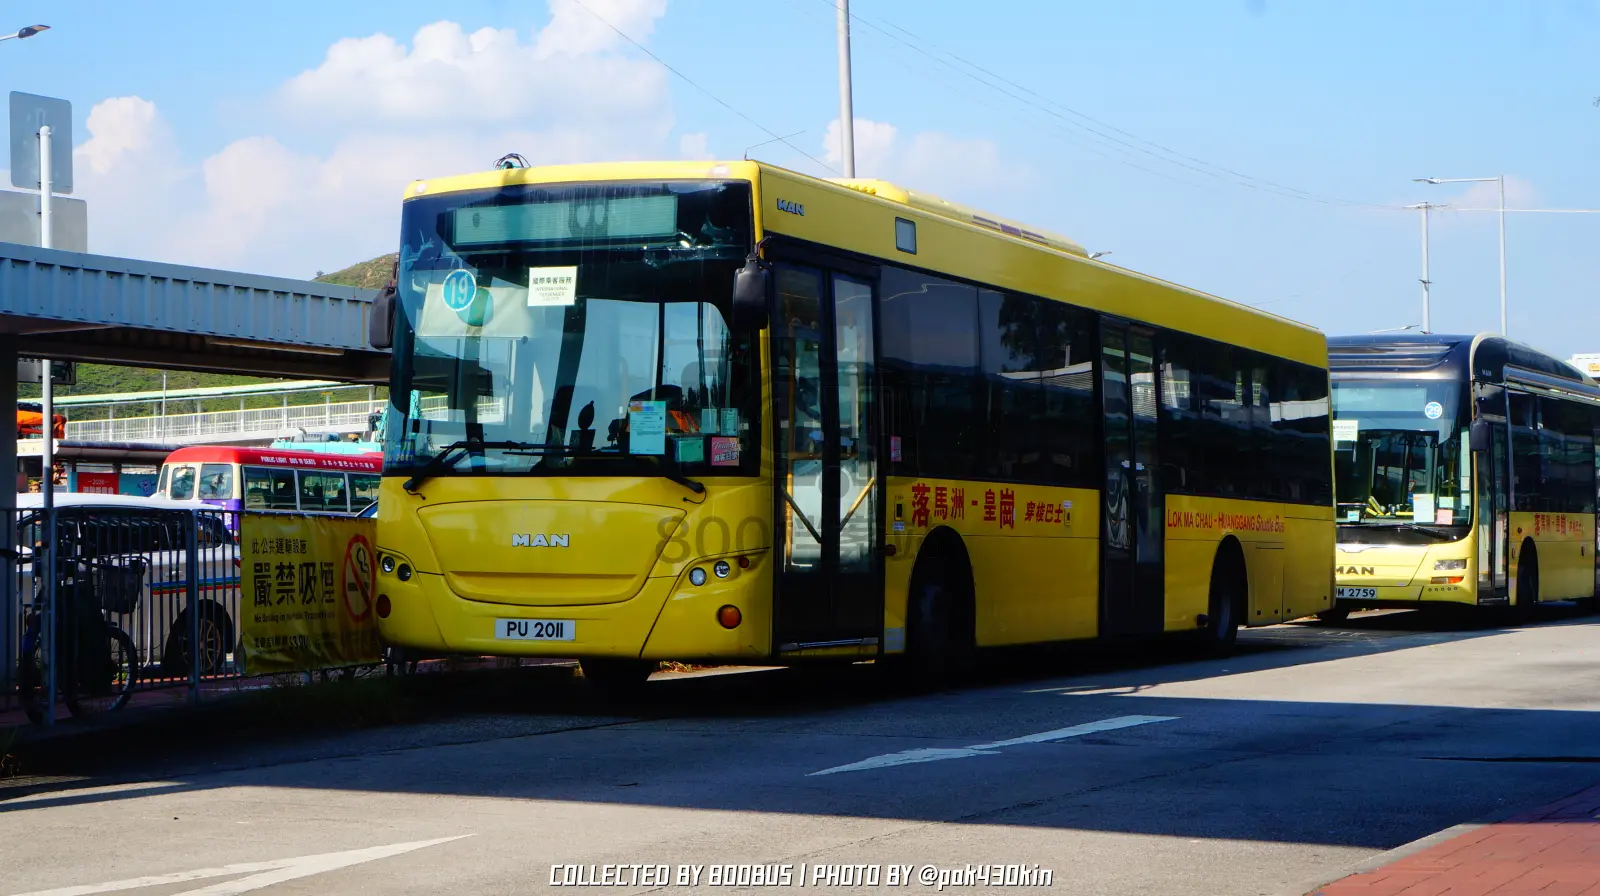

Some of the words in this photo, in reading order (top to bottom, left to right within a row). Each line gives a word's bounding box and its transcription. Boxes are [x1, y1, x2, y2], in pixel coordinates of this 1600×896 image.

[777, 198, 804, 216] MAN
[450, 276, 469, 305] 19
[1427, 405, 1440, 416] 29
[260, 455, 275, 464] PUBLIC
[275, 456, 287, 464] LIGHT
[289, 457, 298, 465] BUS
[912, 483, 965, 528] 落馬洲
[983, 488, 1015, 529] 皇崗
[1024, 501, 1064, 523] 穿梭巴士
[1167, 509, 1182, 528] LOK
[1183, 511, 1194, 529] MA
[1196, 512, 1213, 529] CHAU
[1218, 512, 1255, 531] HUANGGANG
[1256, 514, 1274, 532] Shuttle
[1274, 515, 1285, 533] Bus
[252, 538, 307, 555] 此公共運輸設施
[512, 533, 570, 548] MAN
[253, 562, 335, 608] 嚴禁吸煙
[1336, 588, 1345, 597] M
[1348, 588, 1376, 598] 2759
[507, 621, 528, 637] PU
[534, 622, 564, 638] 2011
